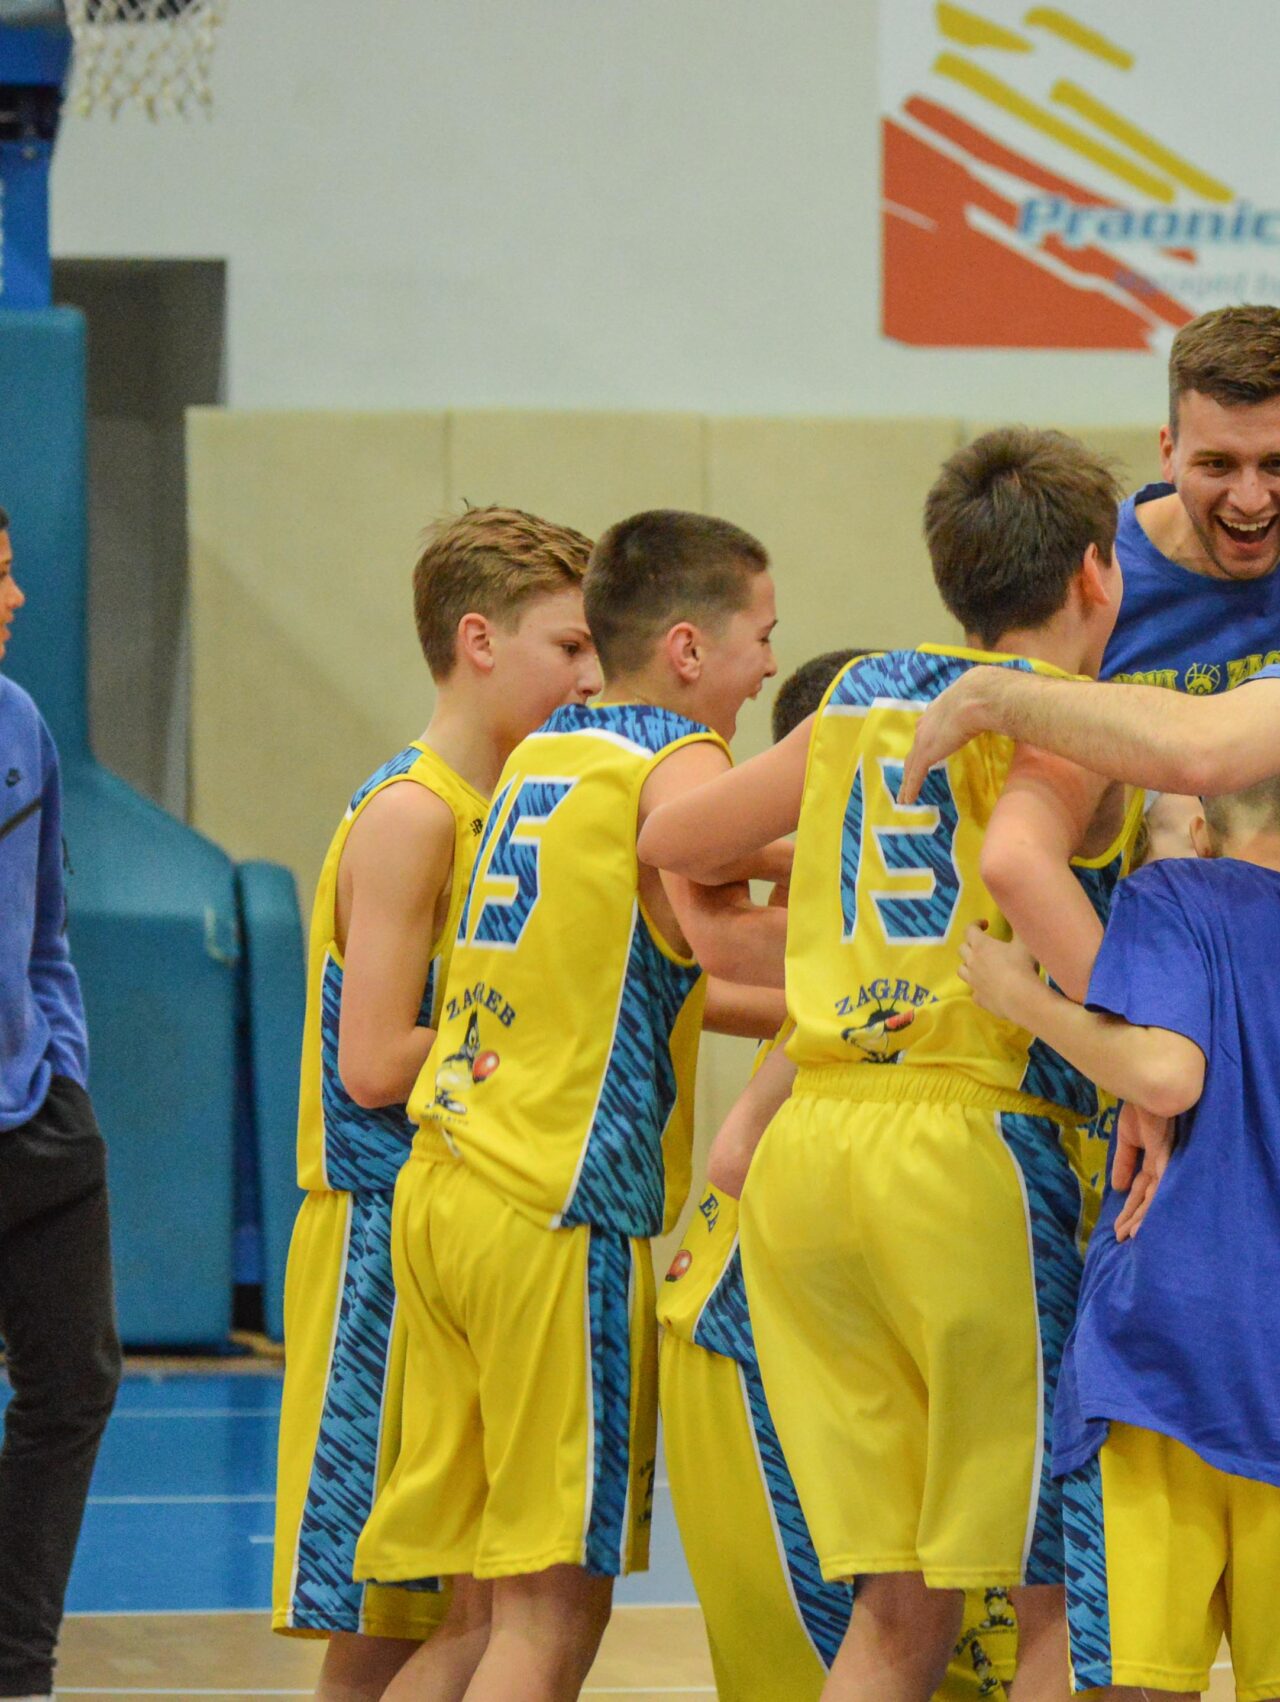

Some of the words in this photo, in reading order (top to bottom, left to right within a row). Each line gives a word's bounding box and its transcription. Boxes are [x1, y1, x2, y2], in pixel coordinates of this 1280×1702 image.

[452, 770, 582, 952] 15
[838, 754, 962, 945] 13
[835, 978, 940, 1017] ZAGRE
